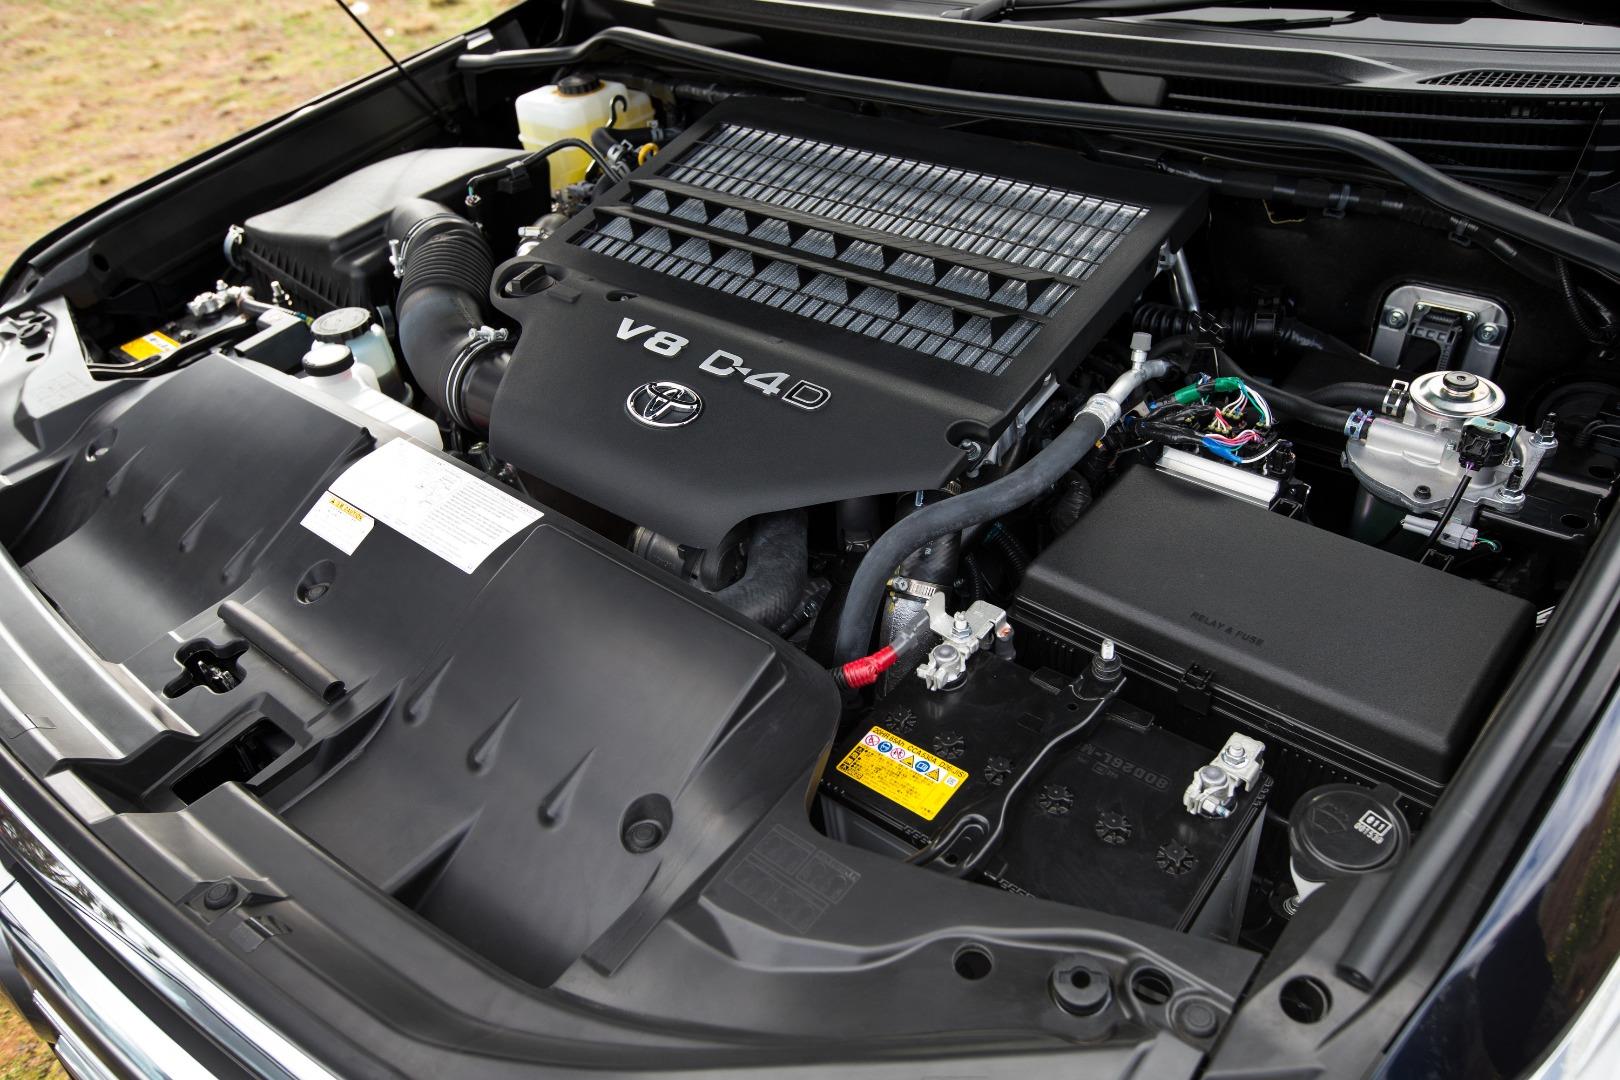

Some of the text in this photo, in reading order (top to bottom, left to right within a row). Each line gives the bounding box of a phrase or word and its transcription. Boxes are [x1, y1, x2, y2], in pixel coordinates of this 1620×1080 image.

[616, 317, 832, 410] V8 D-4D
[1190, 611, 1225, 630] RELAY
[1235, 630, 1264, 646] FUSE
[907, 745, 921, 756] CCA
